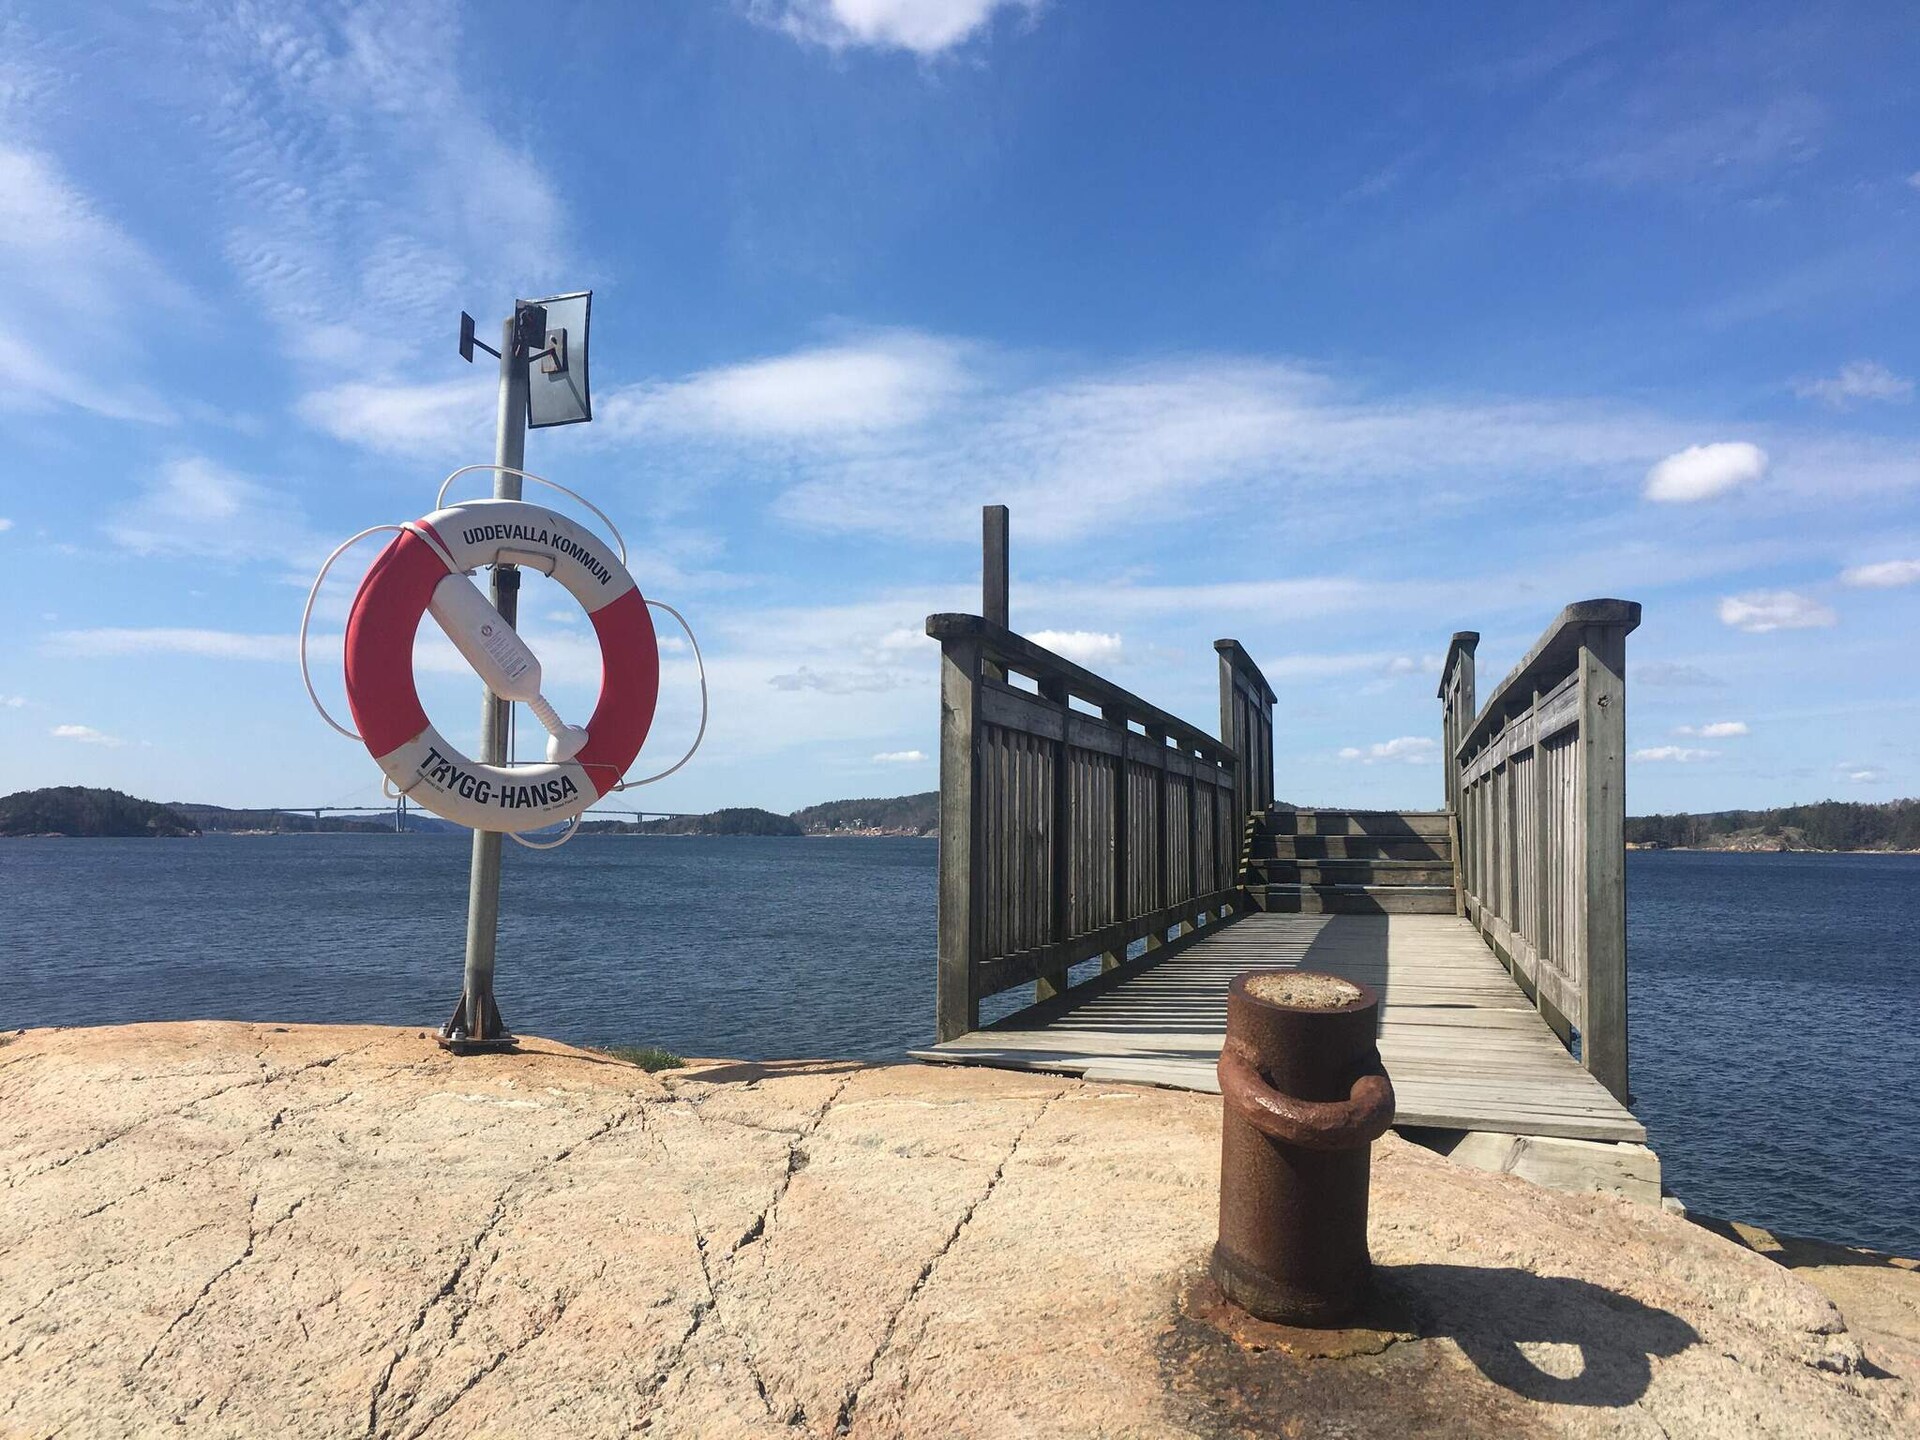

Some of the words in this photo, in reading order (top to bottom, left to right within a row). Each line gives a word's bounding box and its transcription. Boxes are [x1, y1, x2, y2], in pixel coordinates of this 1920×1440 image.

[463, 525, 548, 545] UDDEVALLA
[551, 533, 612, 586] KOMMUN
[421, 747, 578, 808] TRYGG-HANSA
